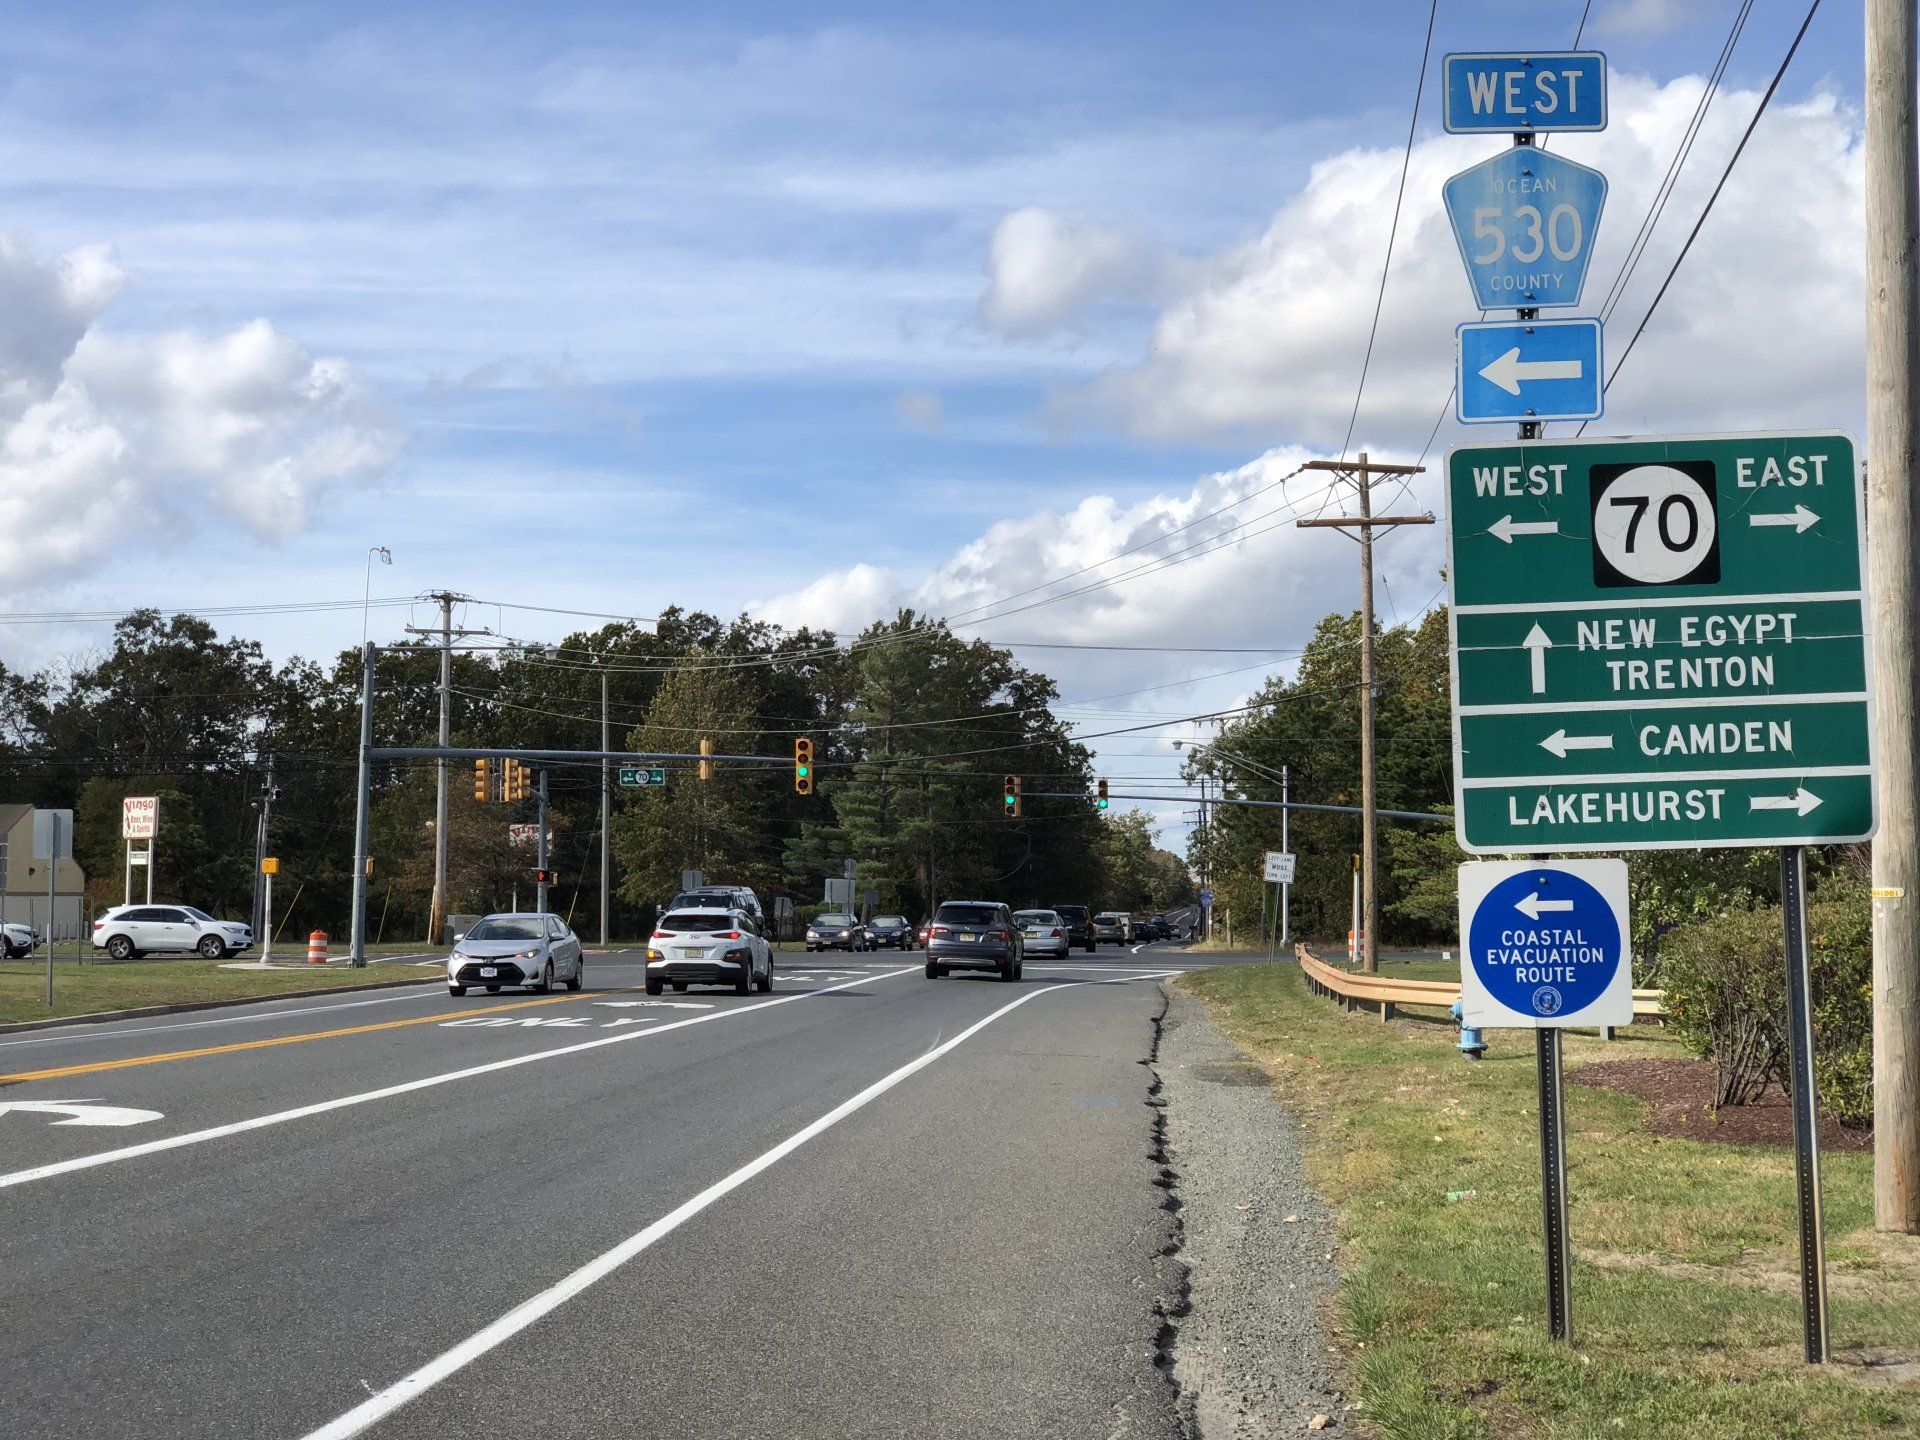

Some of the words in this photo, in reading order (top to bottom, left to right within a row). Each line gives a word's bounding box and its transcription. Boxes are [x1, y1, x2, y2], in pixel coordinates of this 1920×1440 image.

[1467, 70, 1583, 115] WEST
[1494, 177, 1557, 195] OCEAN
[1472, 203, 1583, 266] 530
[1490, 273, 1564, 291] COUNTY
[1472, 464, 1568, 498] WEST
[1735, 455, 1829, 489] EAST
[1609, 493, 1699, 554] 70
[1576, 618, 1656, 651] NEW
[1680, 613, 1798, 646] EGYPT
[1606, 654, 1775, 691] TRENTON
[1639, 720, 1794, 757] CAMDEN
[1509, 788, 1726, 826] LAKEHURST
[1501, 929, 1588, 946] COASTAL
[1487, 947, 1604, 965] EVACUATION
[1515, 966, 1577, 983] ROUTE
